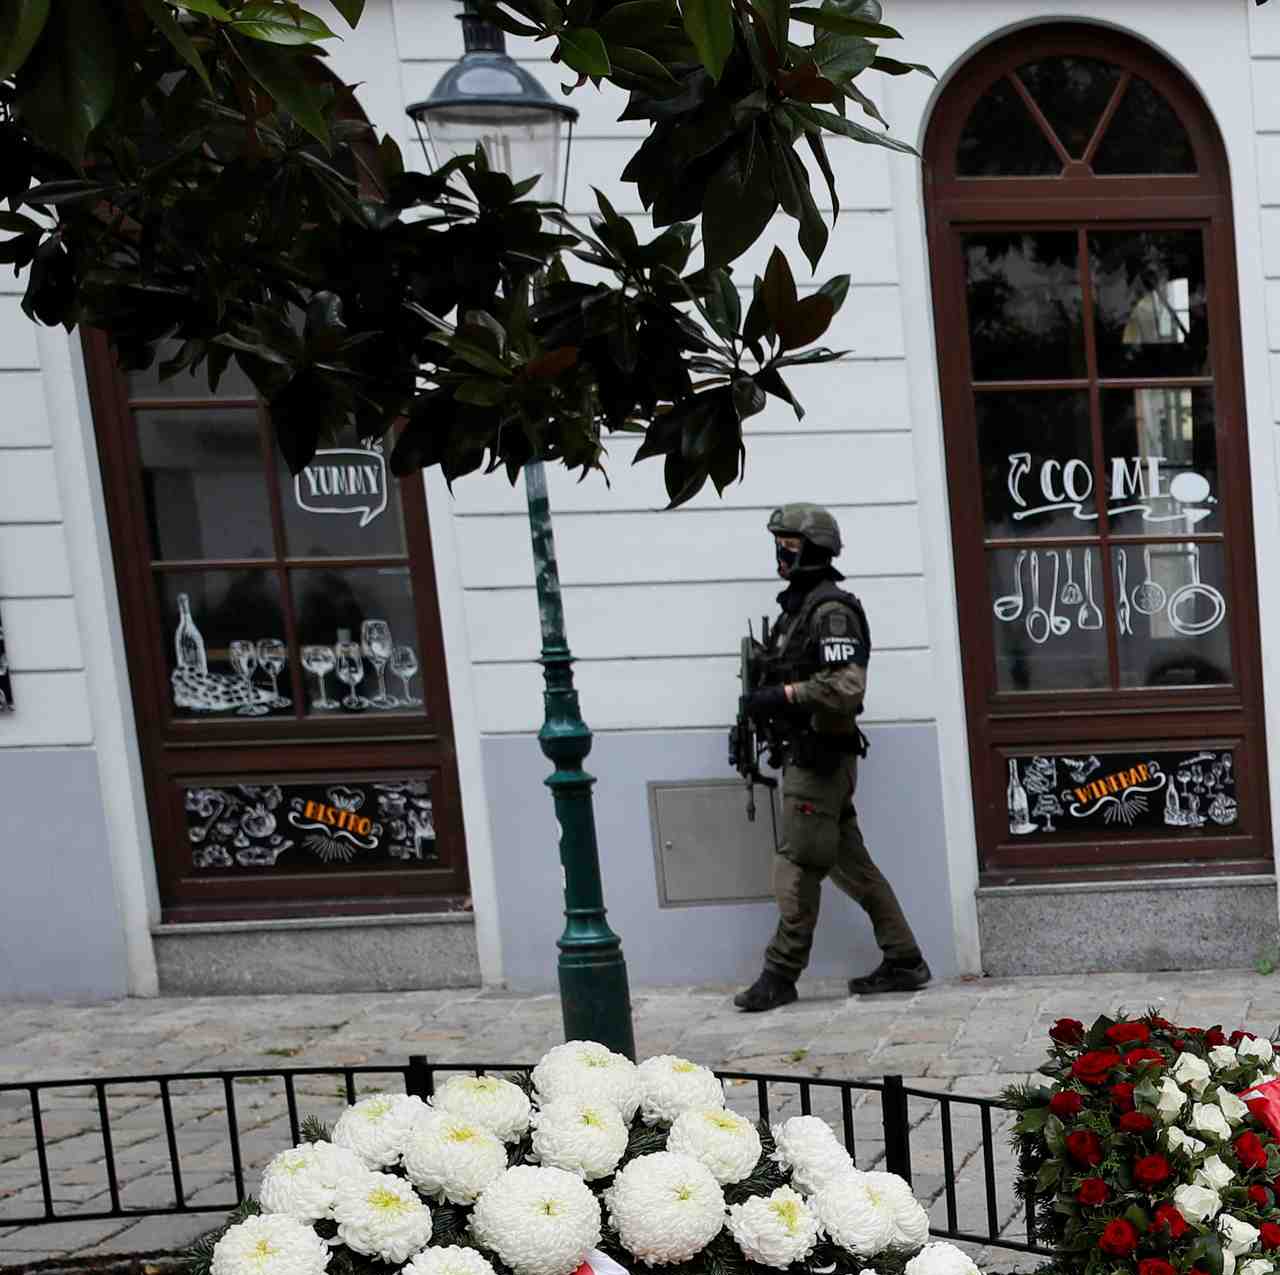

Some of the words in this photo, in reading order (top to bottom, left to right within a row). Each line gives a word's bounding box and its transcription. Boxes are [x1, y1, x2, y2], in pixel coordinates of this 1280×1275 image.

[303, 465, 379, 496] YUMMY
[824, 644, 855, 662] MP
[304, 799, 371, 836] BISTRO
